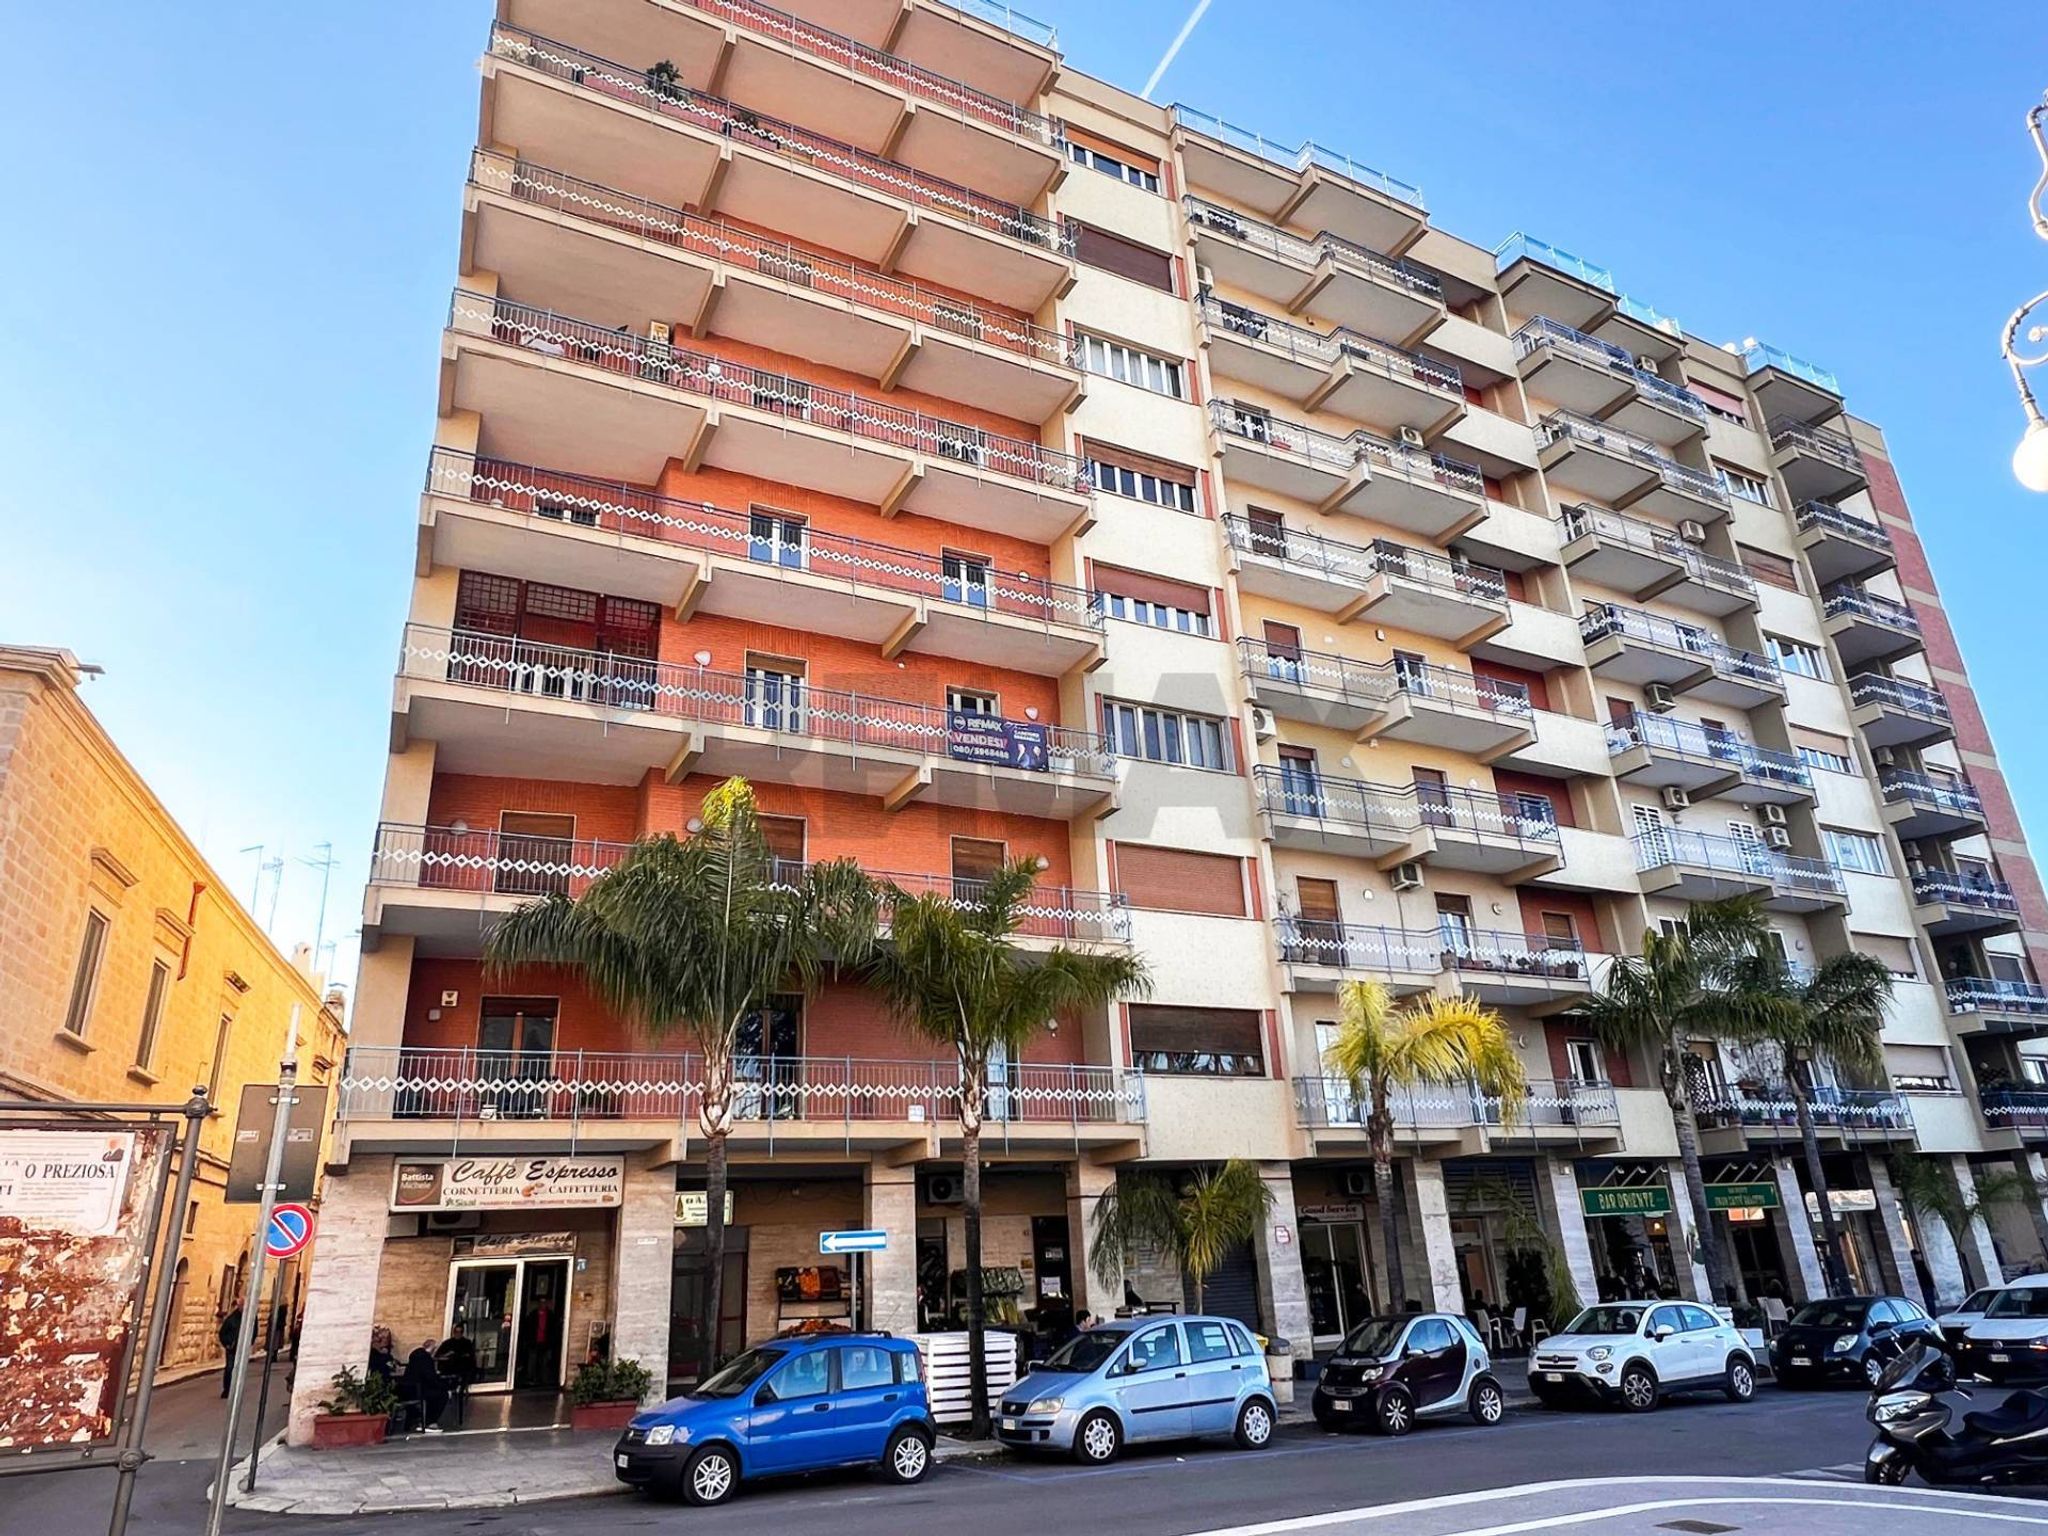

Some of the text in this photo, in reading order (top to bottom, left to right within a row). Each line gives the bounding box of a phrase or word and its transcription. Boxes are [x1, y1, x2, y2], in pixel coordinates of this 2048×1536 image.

[25, 1163, 115, 1178] O PREZIOSA
[401, 1173, 434, 1181] Battista
[525, 1160, 618, 1183] Espresso
[443, 1184, 618, 1196] CORNETTERIA CAFFETTERIA
[1598, 1192, 1655, 1209] BAR ORIENTE
